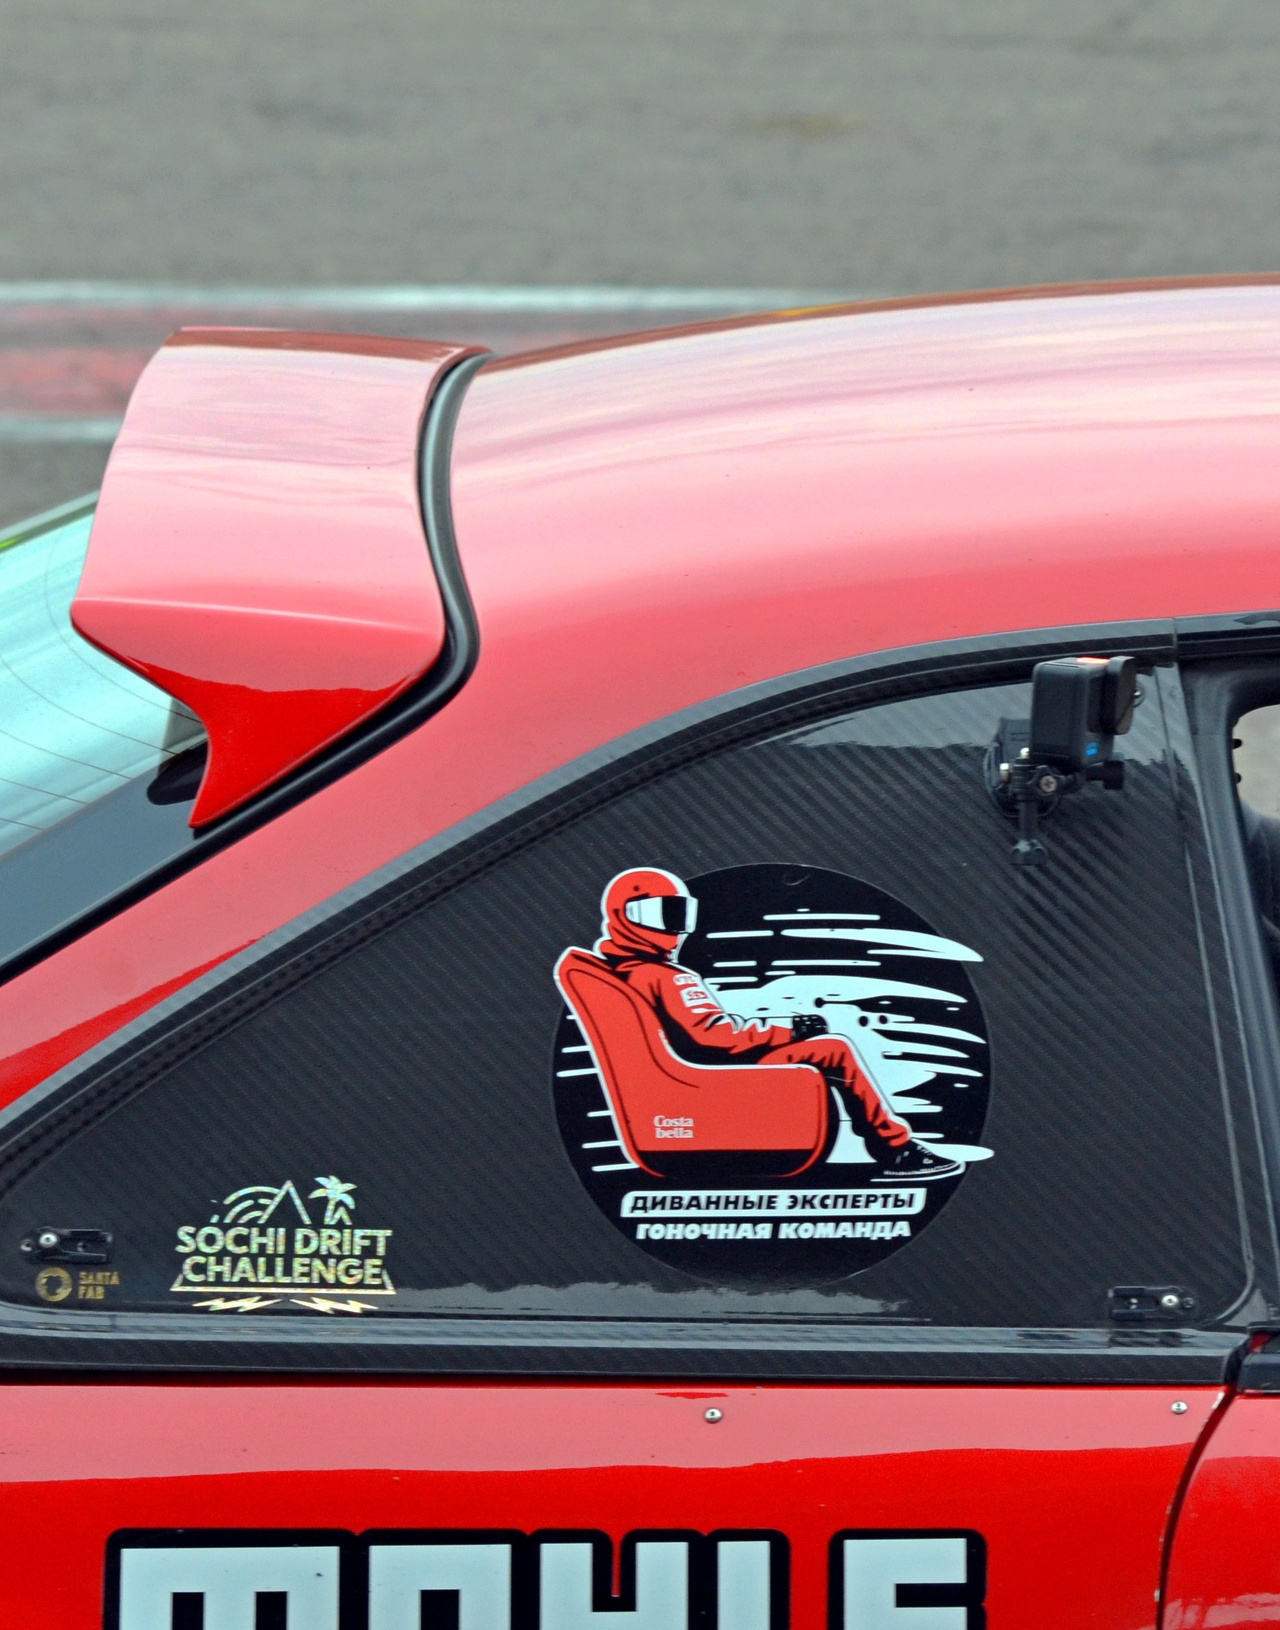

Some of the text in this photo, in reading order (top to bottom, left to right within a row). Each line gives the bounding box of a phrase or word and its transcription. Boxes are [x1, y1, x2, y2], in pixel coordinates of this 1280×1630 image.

[653, 1114, 694, 1127] Costa
[655, 1127, 694, 1139] bella
[630, 1192, 916, 1213] ДИВАННЫЕ ЭКСПЕРТЫ
[636, 1221, 911, 1240] ГОНОЧНАЯ КОМАНДА
[175, 1226, 392, 1256] SOCHI DRIFT
[79, 1272, 120, 1285] SANTA
[182, 1256, 383, 1285] CHALLENGE
